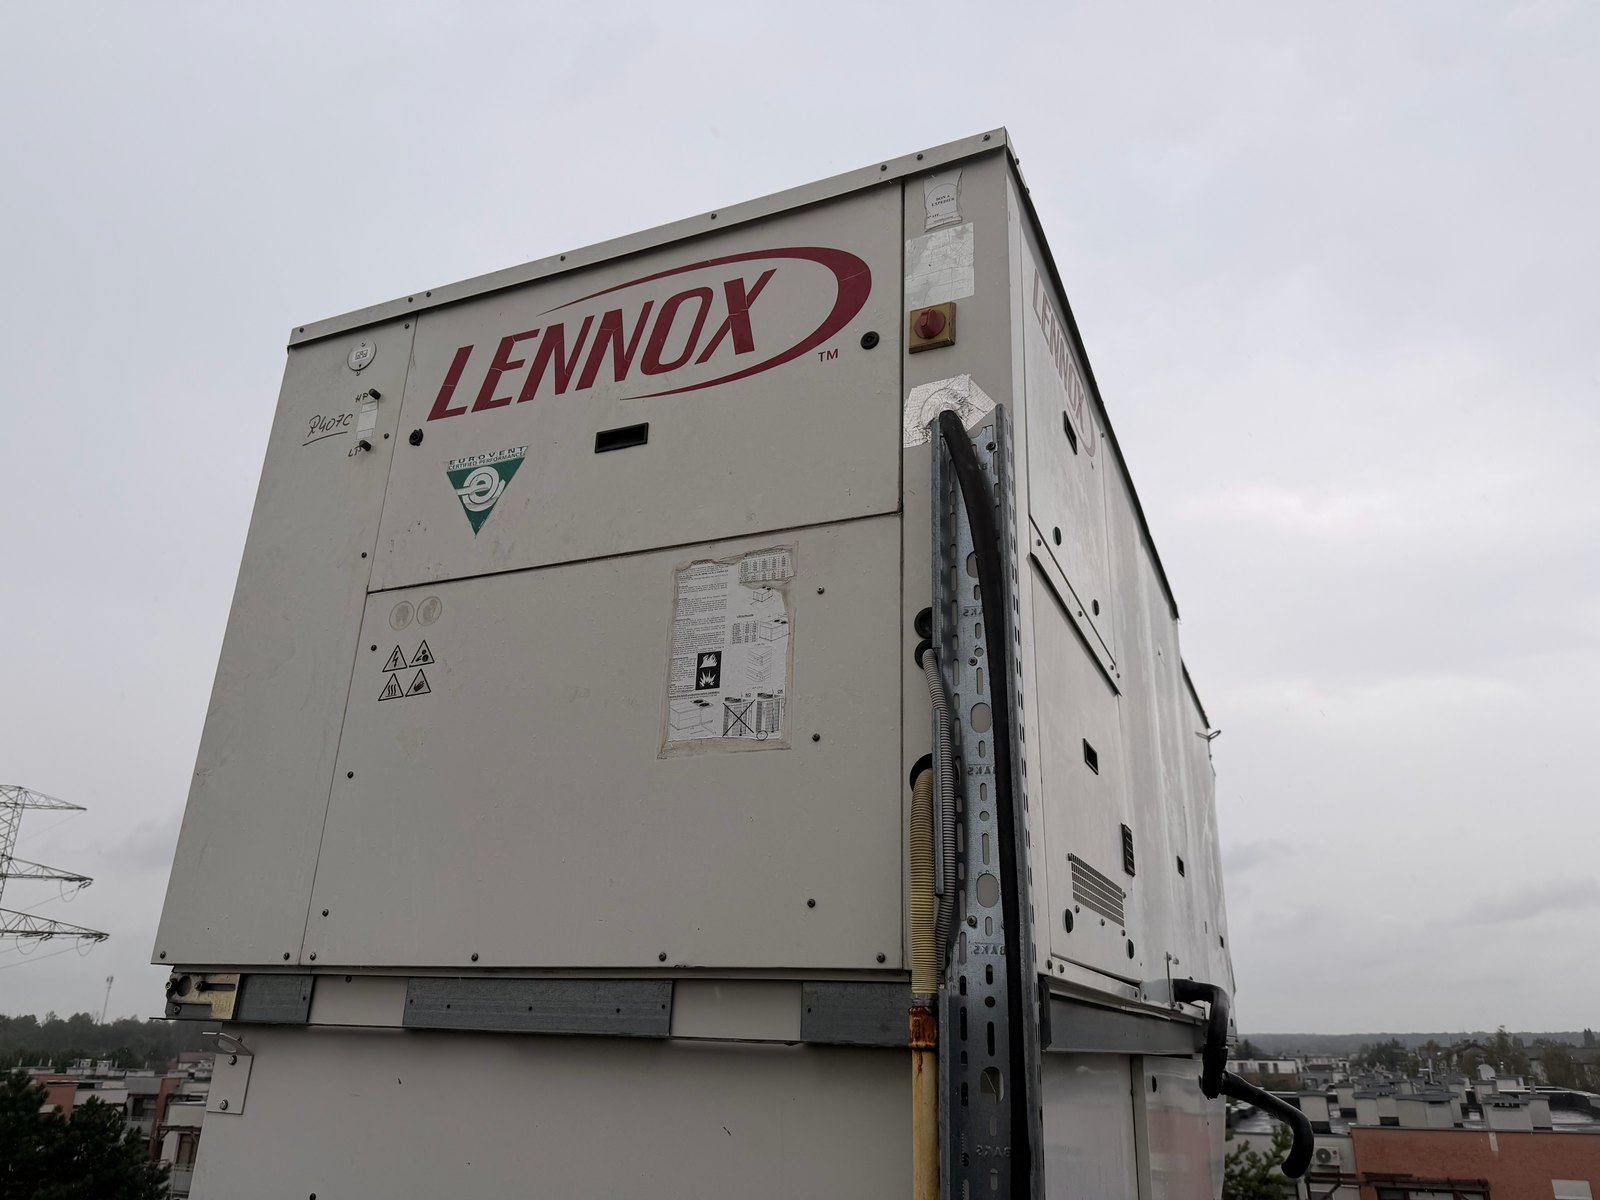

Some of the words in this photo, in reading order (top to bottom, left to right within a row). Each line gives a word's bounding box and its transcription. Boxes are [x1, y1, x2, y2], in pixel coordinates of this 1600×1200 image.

[427, 267, 777, 421] LENNOX
[1033, 268, 1085, 434] LENNOX
[818, 348, 839, 363] TM
[355, 392, 369, 404] HP
[307, 414, 354, 438] R407C
[348, 445, 362, 457] LP
[449, 445, 528, 464] EUROVENT
[448, 460, 478, 471] CERTIFIED
[478, 451, 526, 465] PERFORMANCE
